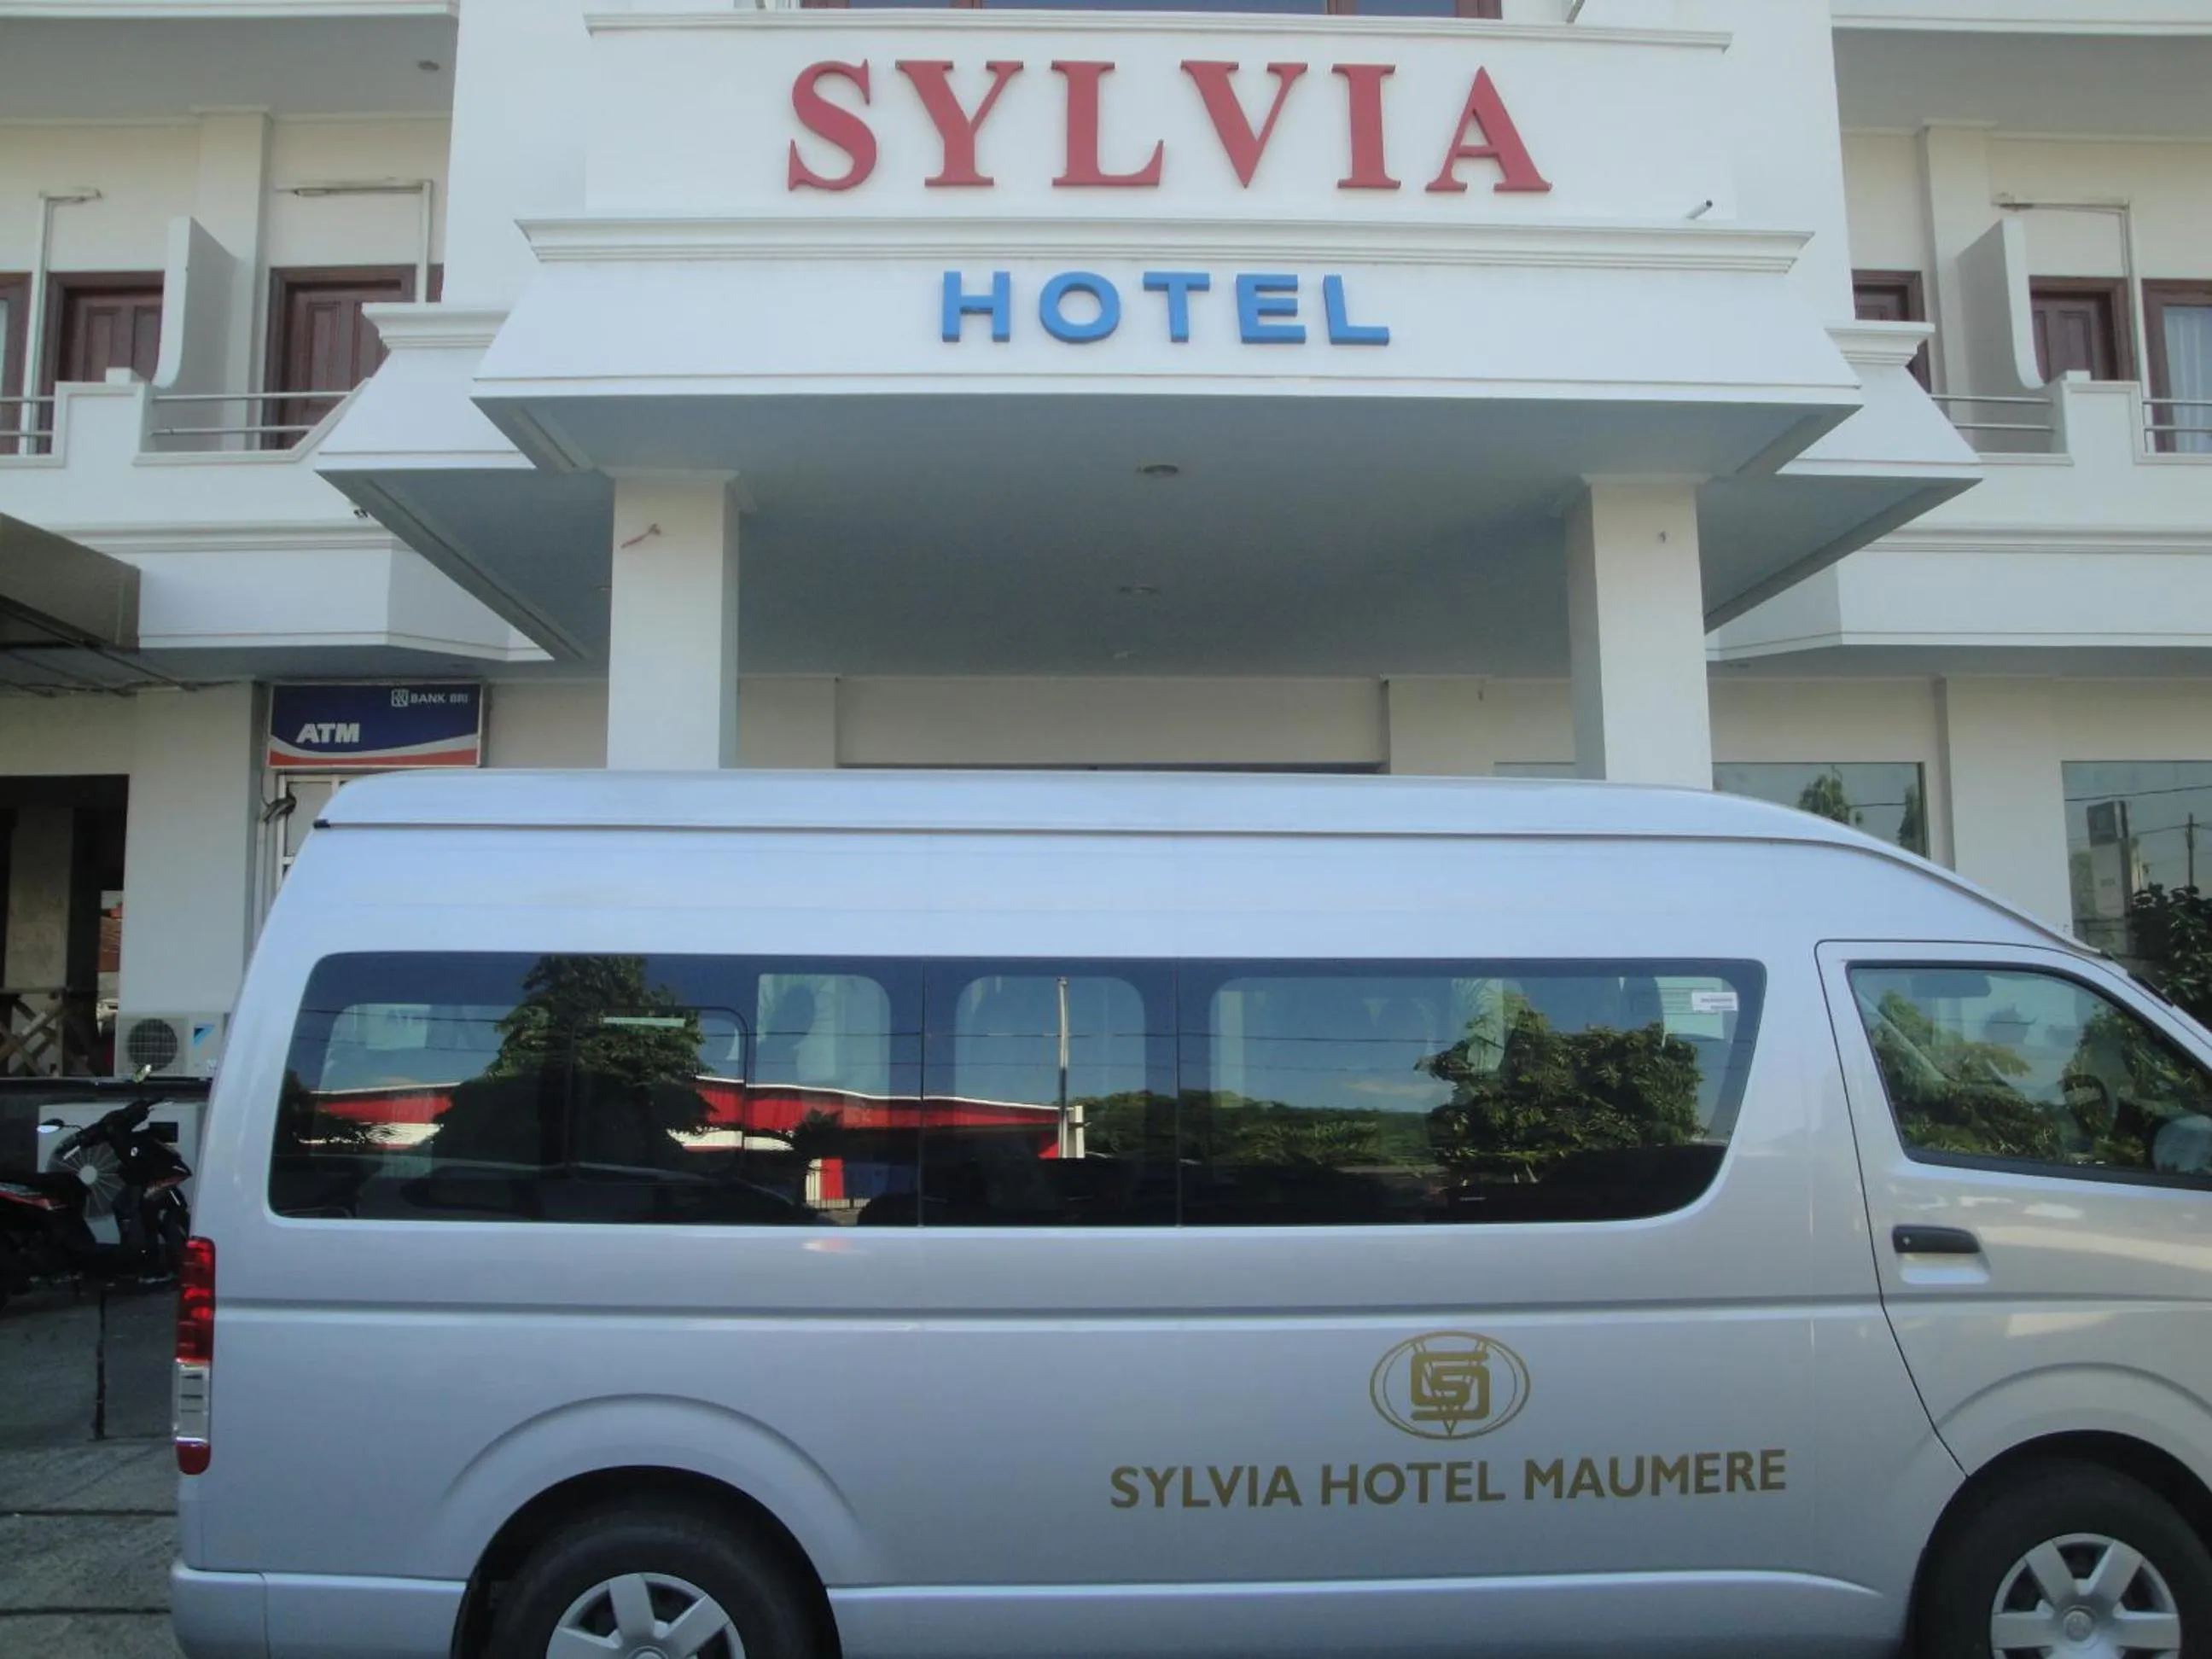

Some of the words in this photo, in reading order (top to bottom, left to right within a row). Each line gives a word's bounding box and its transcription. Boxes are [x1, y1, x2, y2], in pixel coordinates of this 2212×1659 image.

[788, 60, 1551, 192] SYLVIA
[941, 271, 1391, 346] HOTEL
[410, 694, 445, 704] BANK
[449, 694, 469, 704] BRI
[296, 723, 360, 743] ATM
[1110, 1465, 1303, 1508] SYLVIA
[1320, 1460, 1506, 1505] HOTEL
[1524, 1449, 1787, 1499] MAUMERE
